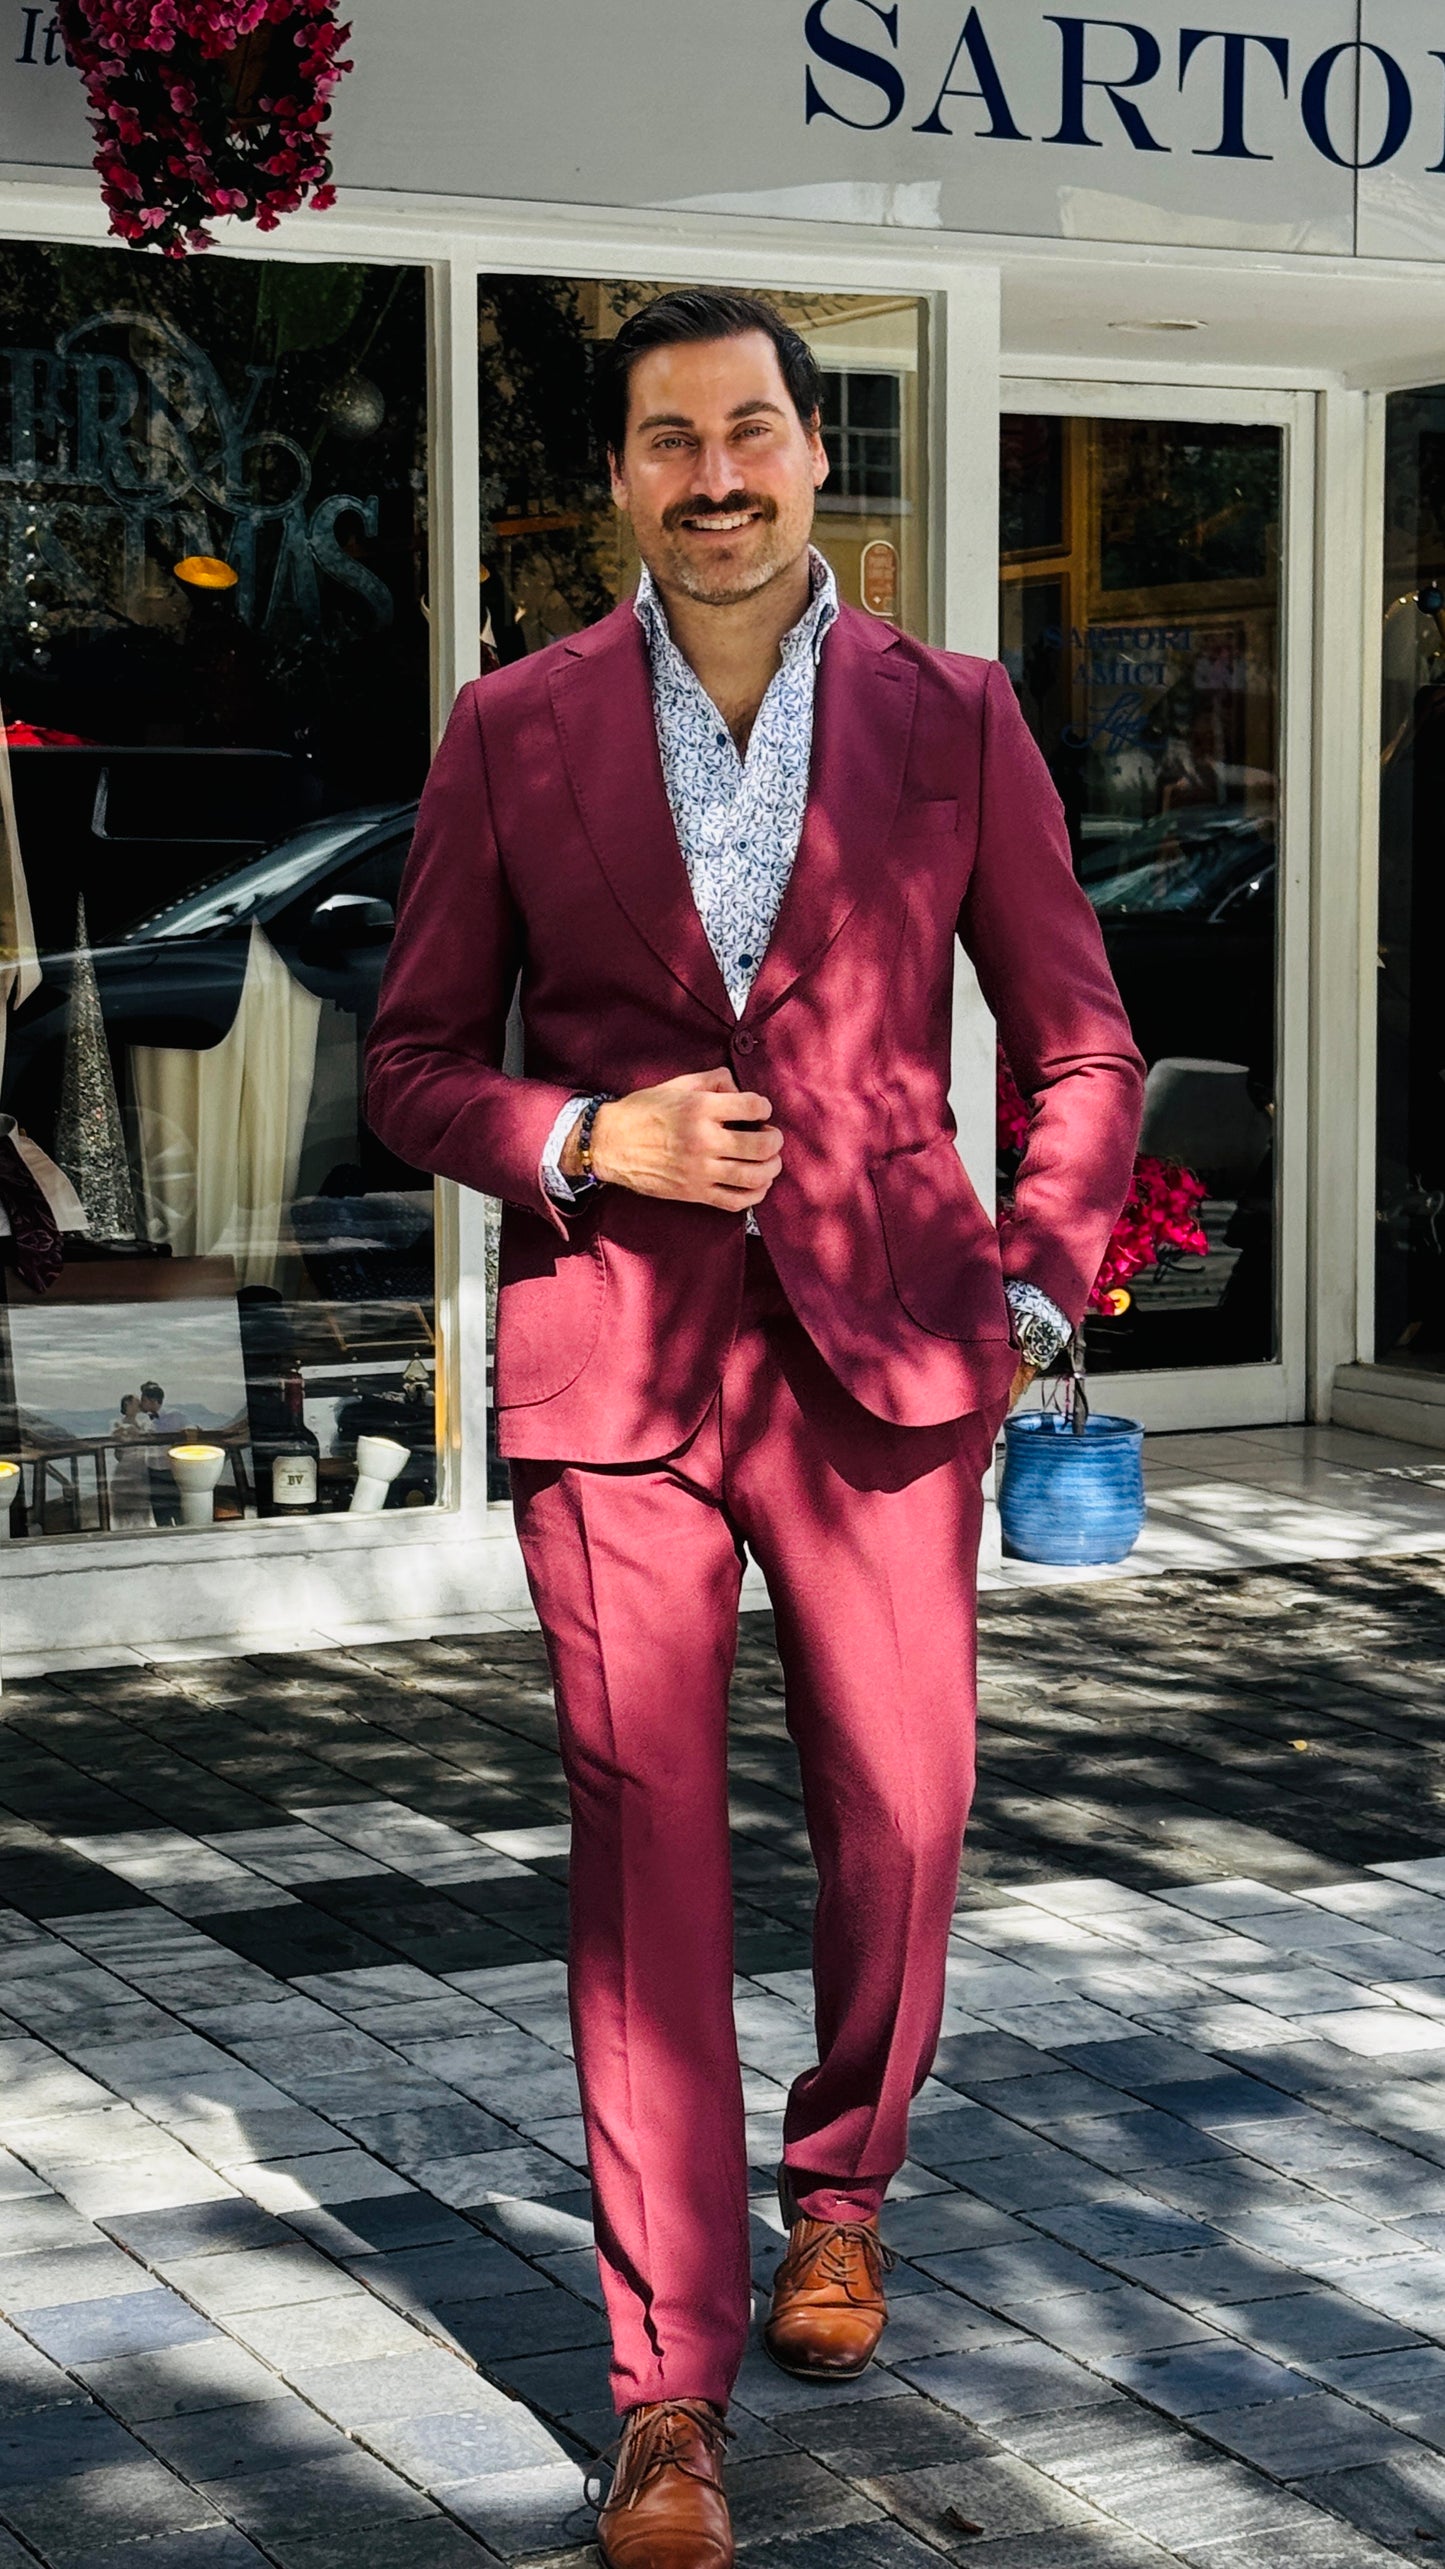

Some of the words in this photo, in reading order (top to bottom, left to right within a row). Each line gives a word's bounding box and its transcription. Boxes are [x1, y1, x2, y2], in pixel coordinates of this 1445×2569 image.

[804, 0, 1445, 174] SARTO
[1042, 624, 1192, 650] SARTORI
[1073, 662, 1168, 687] AMICI
